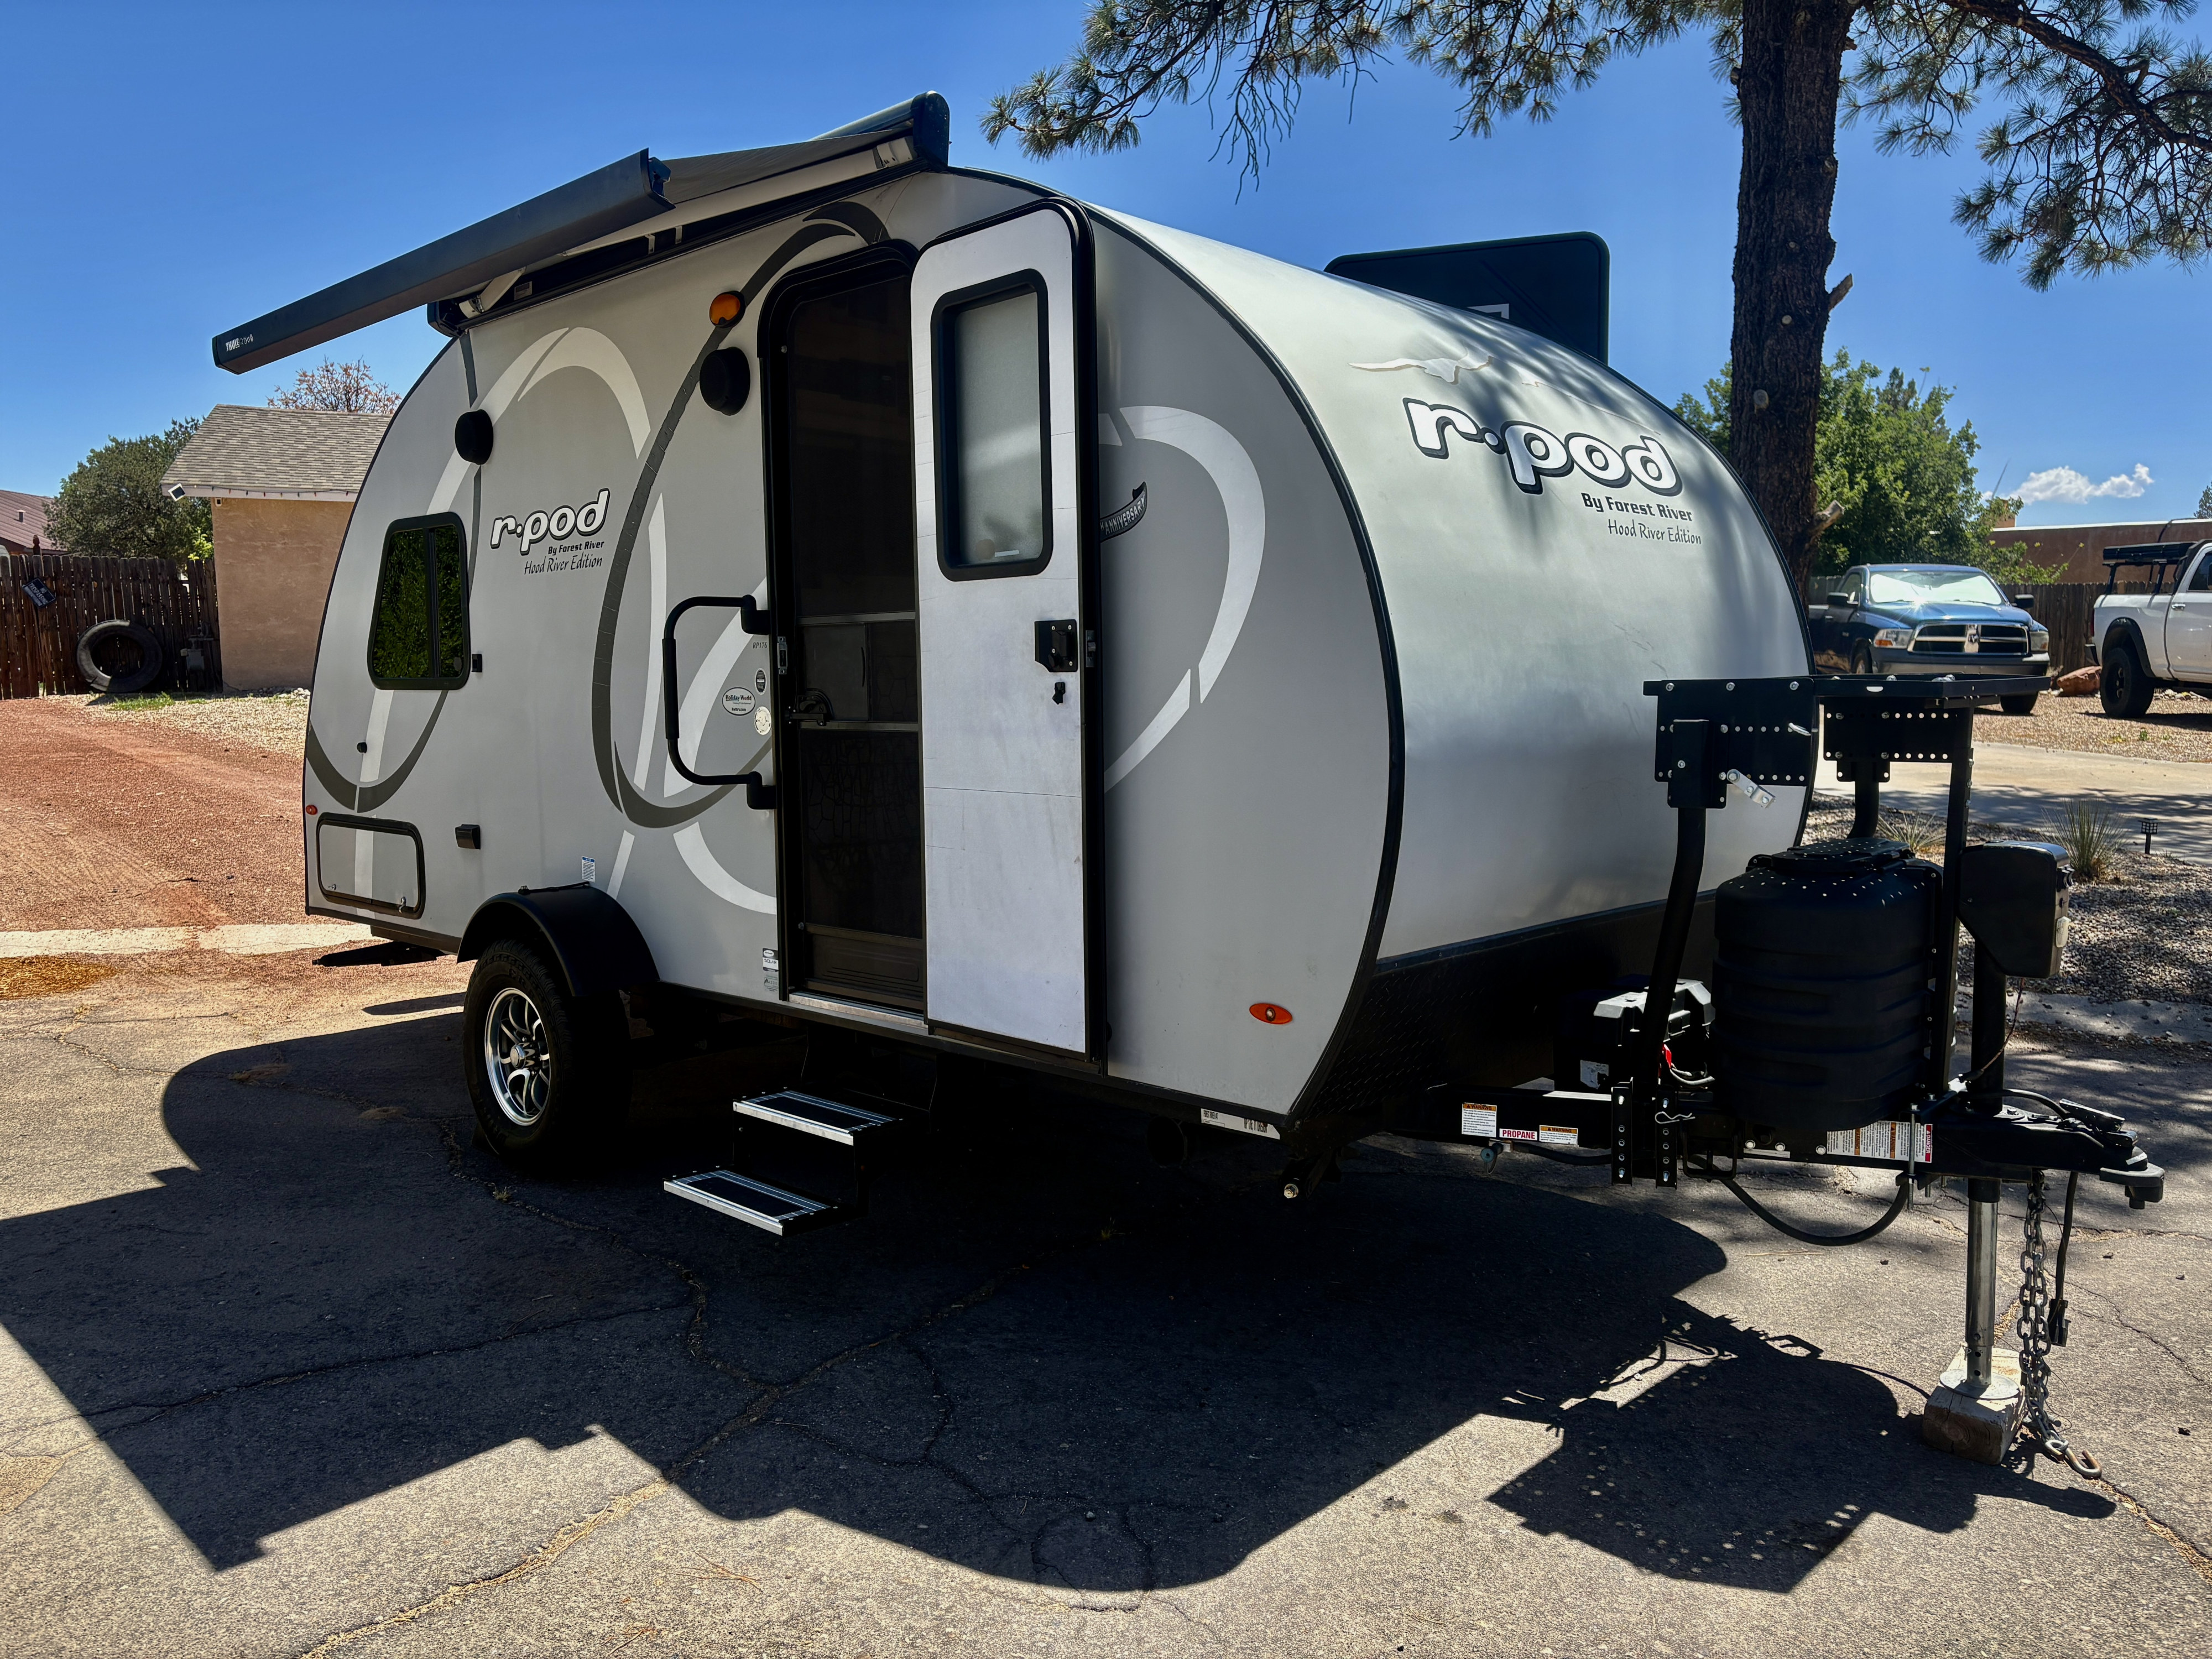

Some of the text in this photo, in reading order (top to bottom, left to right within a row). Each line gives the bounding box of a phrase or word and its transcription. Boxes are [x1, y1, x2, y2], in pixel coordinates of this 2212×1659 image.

[1105, 493, 1145, 535] ANNIVERSARY
[1581, 492, 1692, 521] By Forest River
[1608, 519, 1702, 545] Hood River Edition
[548, 541, 604, 556] By Forest River
[524, 551, 603, 575] Hood River Edition
[1502, 1130, 1536, 1139] PROPANE
